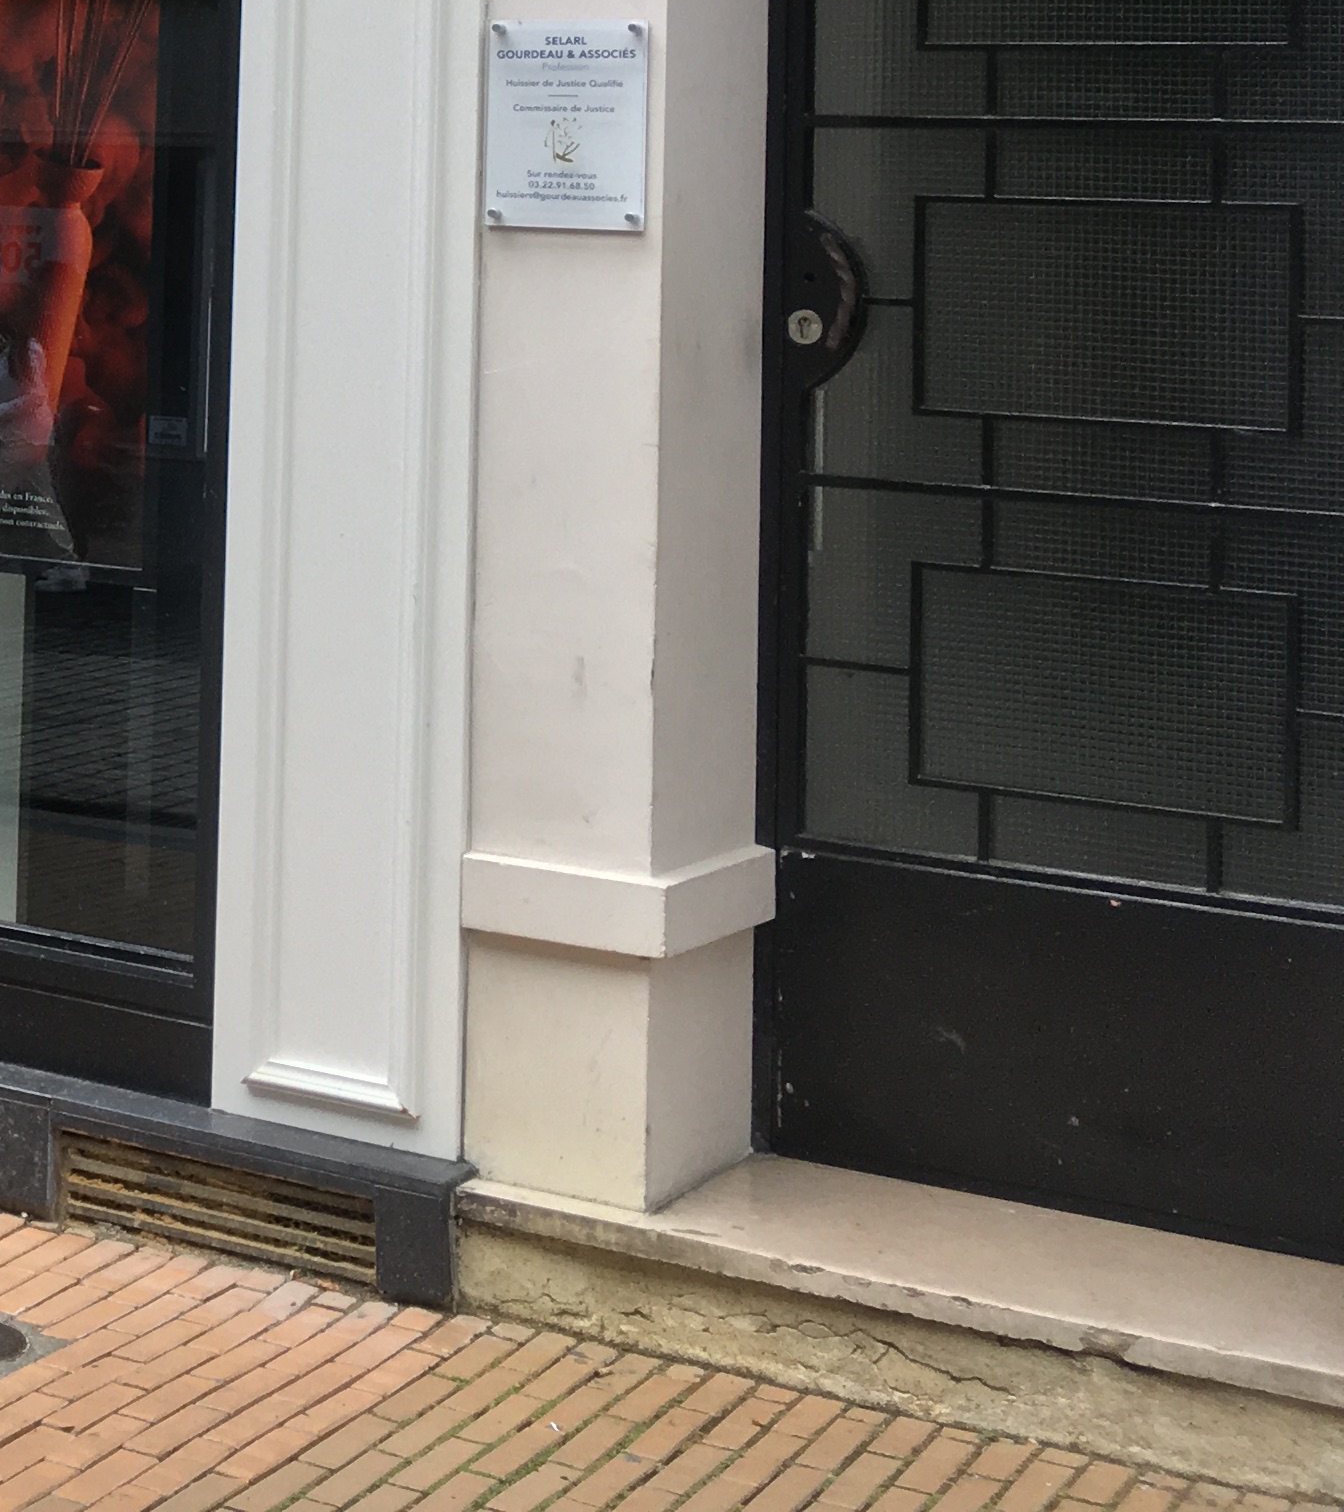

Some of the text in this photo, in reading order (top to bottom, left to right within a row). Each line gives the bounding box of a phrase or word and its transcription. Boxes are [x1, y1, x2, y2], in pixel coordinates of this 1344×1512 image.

[544, 36, 588, 46] SELARL
[496, 46, 637, 59] GOURDEAU & ASSOCIÉS
[506, 79, 540, 88] Huissier
[542, 79, 554, 88] de
[556, 79, 587, 88] Justice
[512, 103, 615, 113] Commissaire de Justice
[526, 169, 598, 179] Sur rendez-vous
